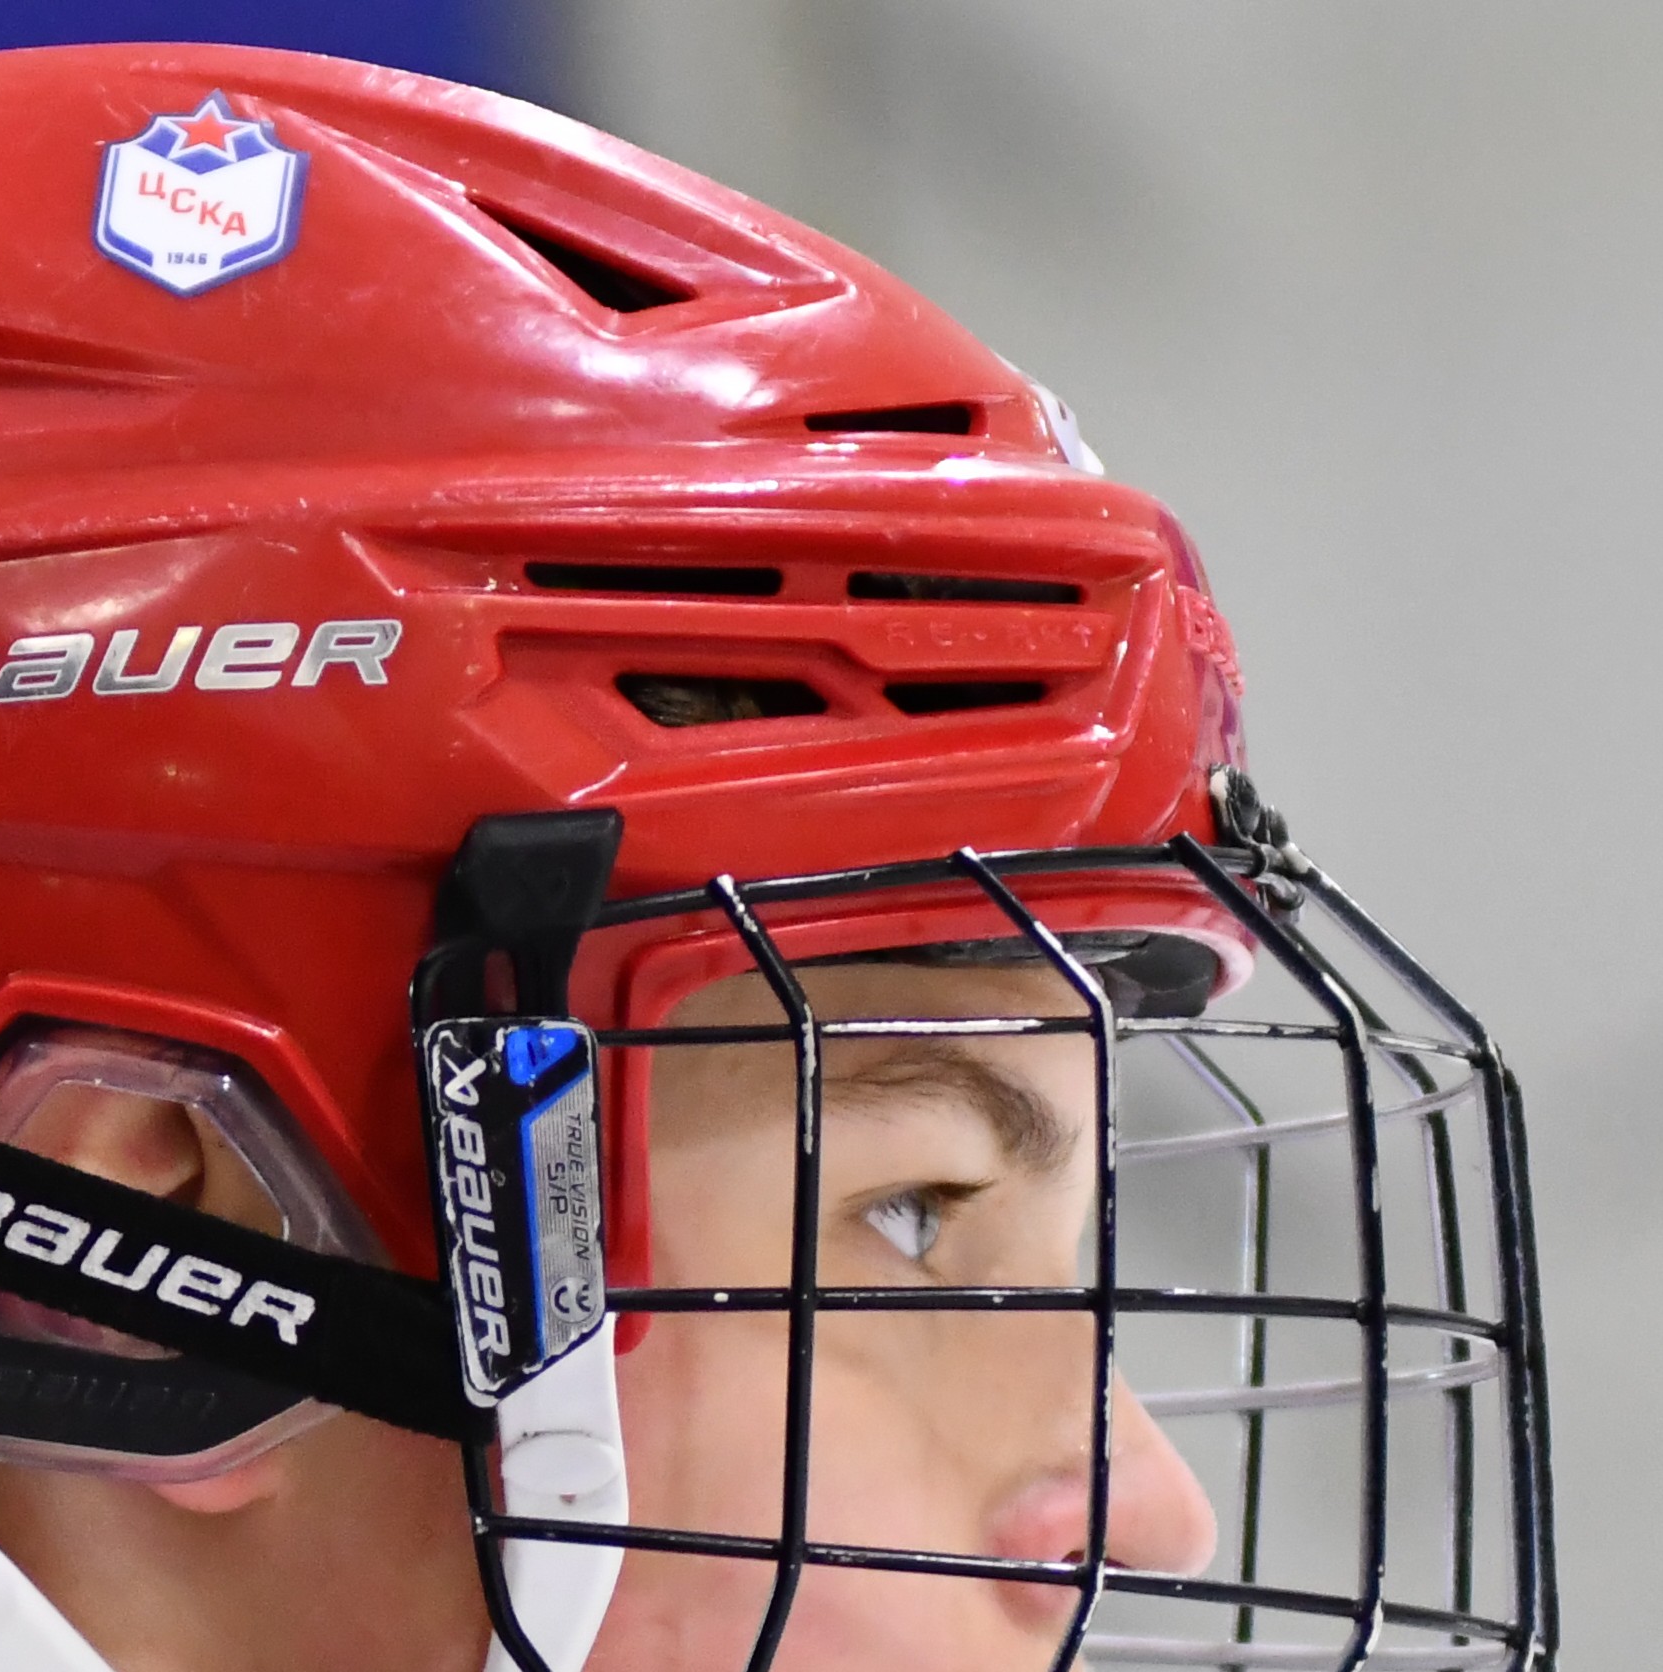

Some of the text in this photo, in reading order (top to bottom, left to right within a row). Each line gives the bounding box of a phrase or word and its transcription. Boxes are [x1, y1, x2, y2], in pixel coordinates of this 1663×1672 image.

[139, 172, 247, 237] ЦСКА
[167, 252, 209, 266] 1946
[546, 1162, 569, 1215] S/P
[567, 1112, 591, 1261] TRUE VISION
